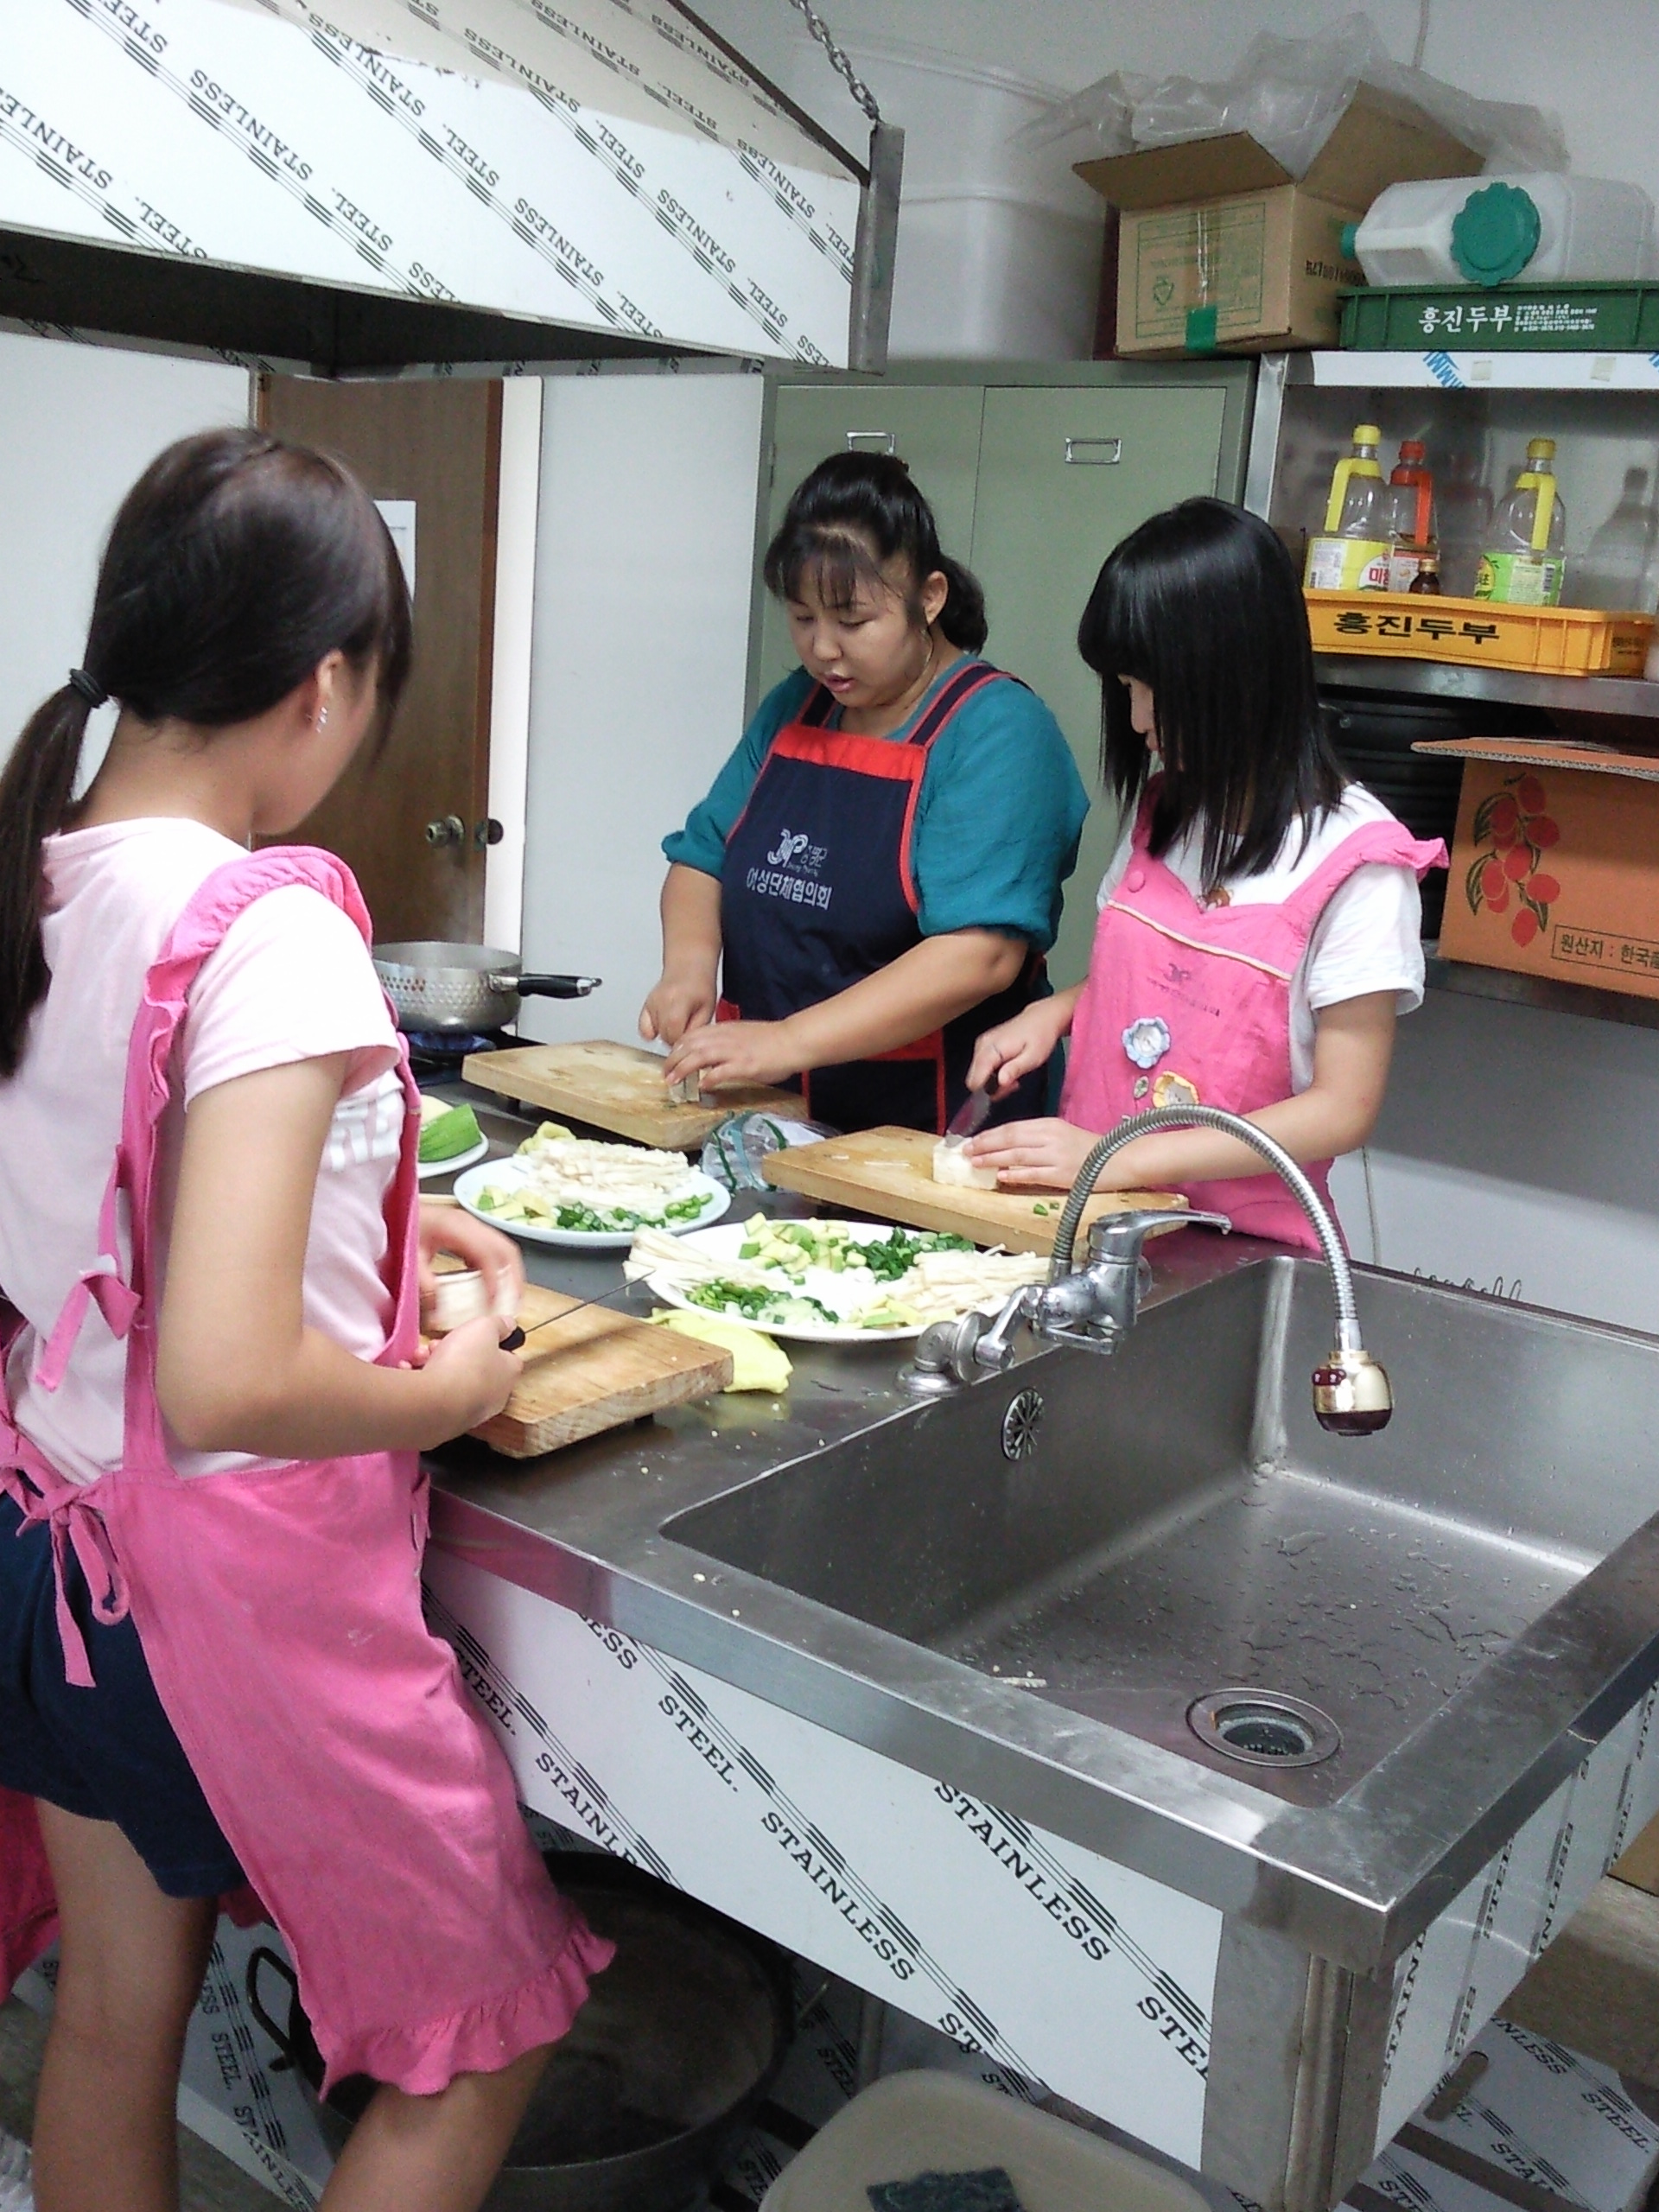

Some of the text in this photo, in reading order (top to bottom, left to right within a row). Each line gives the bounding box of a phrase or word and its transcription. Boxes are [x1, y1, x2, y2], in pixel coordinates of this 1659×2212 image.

[308, 12, 426, 117] STAINLESS
[464, 28, 582, 113] STAINLESS
[531, 0, 641, 77] STAINLESS
[651, 14, 750, 87] STAINLESS
[0, 92, 113, 189] STAINLE
[189, 69, 313, 181] STAINLESS
[442, 123, 500, 187] STEEL.
[595, 119, 645, 179] STEEL.
[736, 138, 816, 219] STAINLESS
[331, 187, 392, 251] STEEL.
[514, 198, 604, 287] STAINLESS
[657, 188, 736, 273] STAINLESS
[747, 277, 788, 327] STEEL.
[1418, 305, 1513, 333] 흥진두부
[1333, 611, 1501, 645] 흥진두부
[747, 867, 833, 911] 여성단체협의회
[1560, 933, 1604, 959] 원산지
[658, 1694, 739, 1792] STEEL.
[761, 1812, 916, 1980] STAINLESS
[933, 1782, 1111, 1961] STAINLESS
[212, 2032, 242, 2091] STEEL.
[1580, 2091, 1649, 2153] STEEL.
